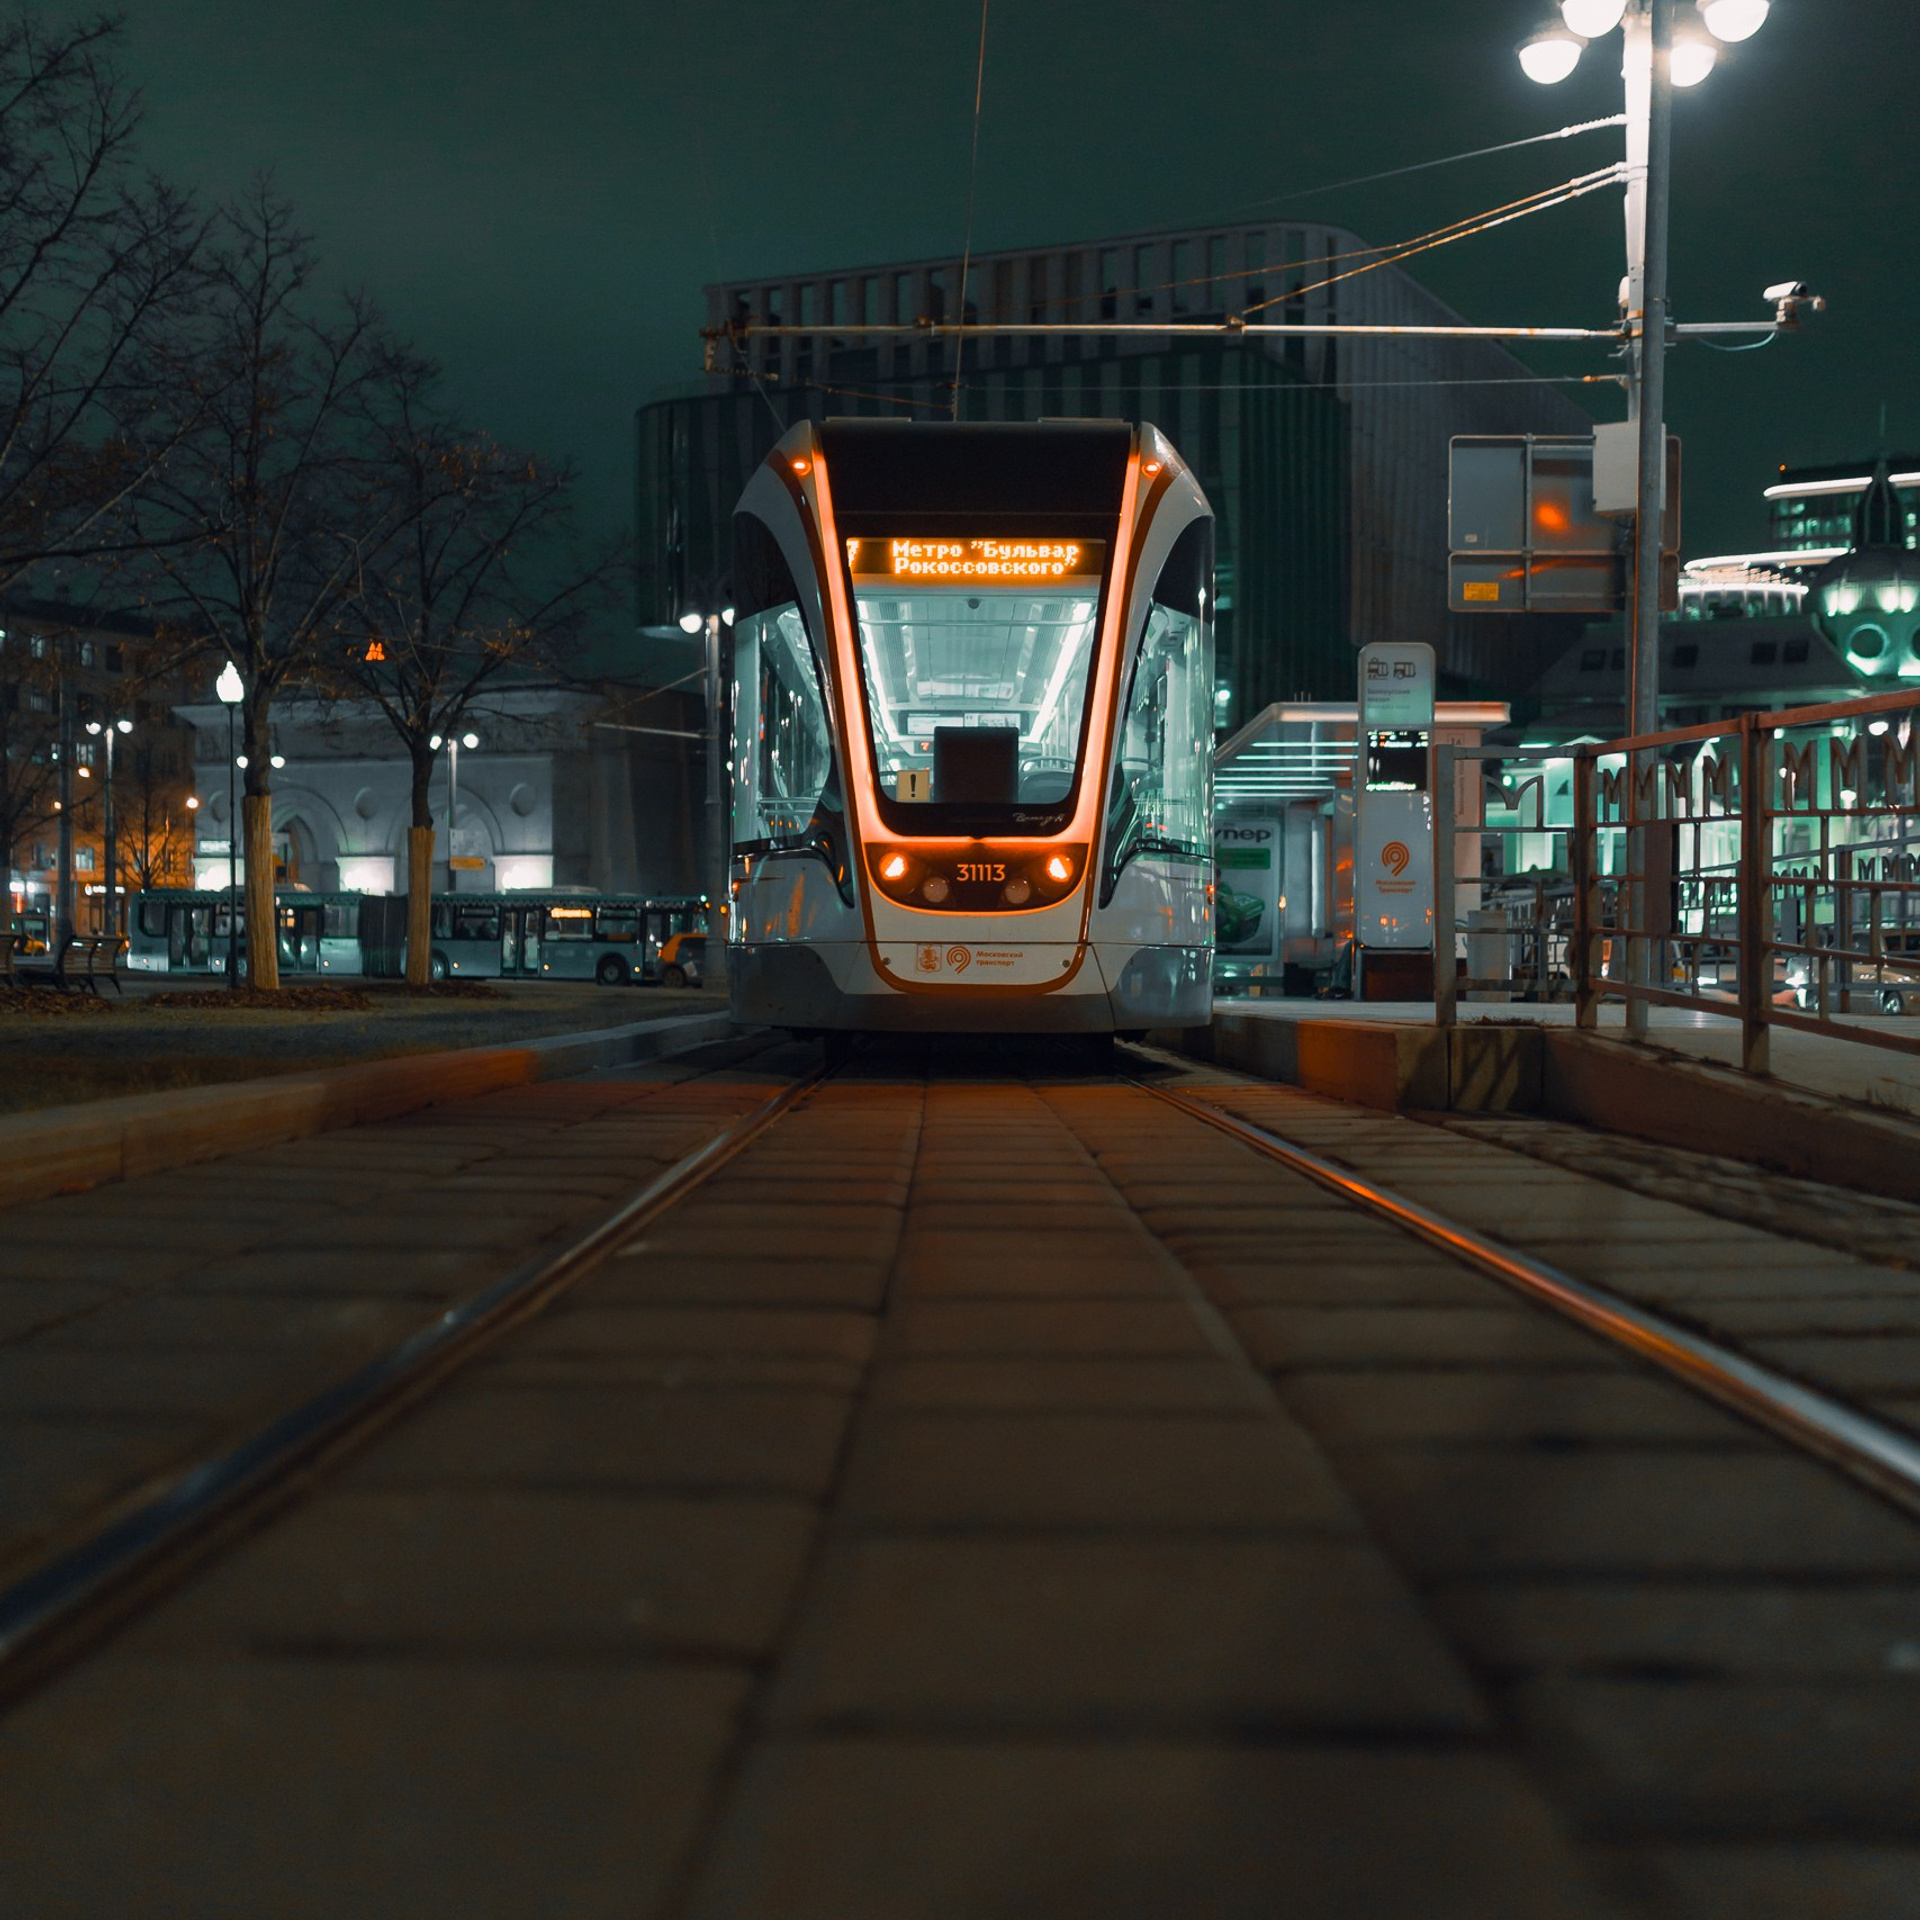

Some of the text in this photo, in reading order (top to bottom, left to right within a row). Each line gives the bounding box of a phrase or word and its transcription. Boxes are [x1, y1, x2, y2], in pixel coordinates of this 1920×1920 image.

[892, 540, 963, 559] Метро
[956, 864, 1005, 882] 31113
[976, 951, 1025, 959] Московский
